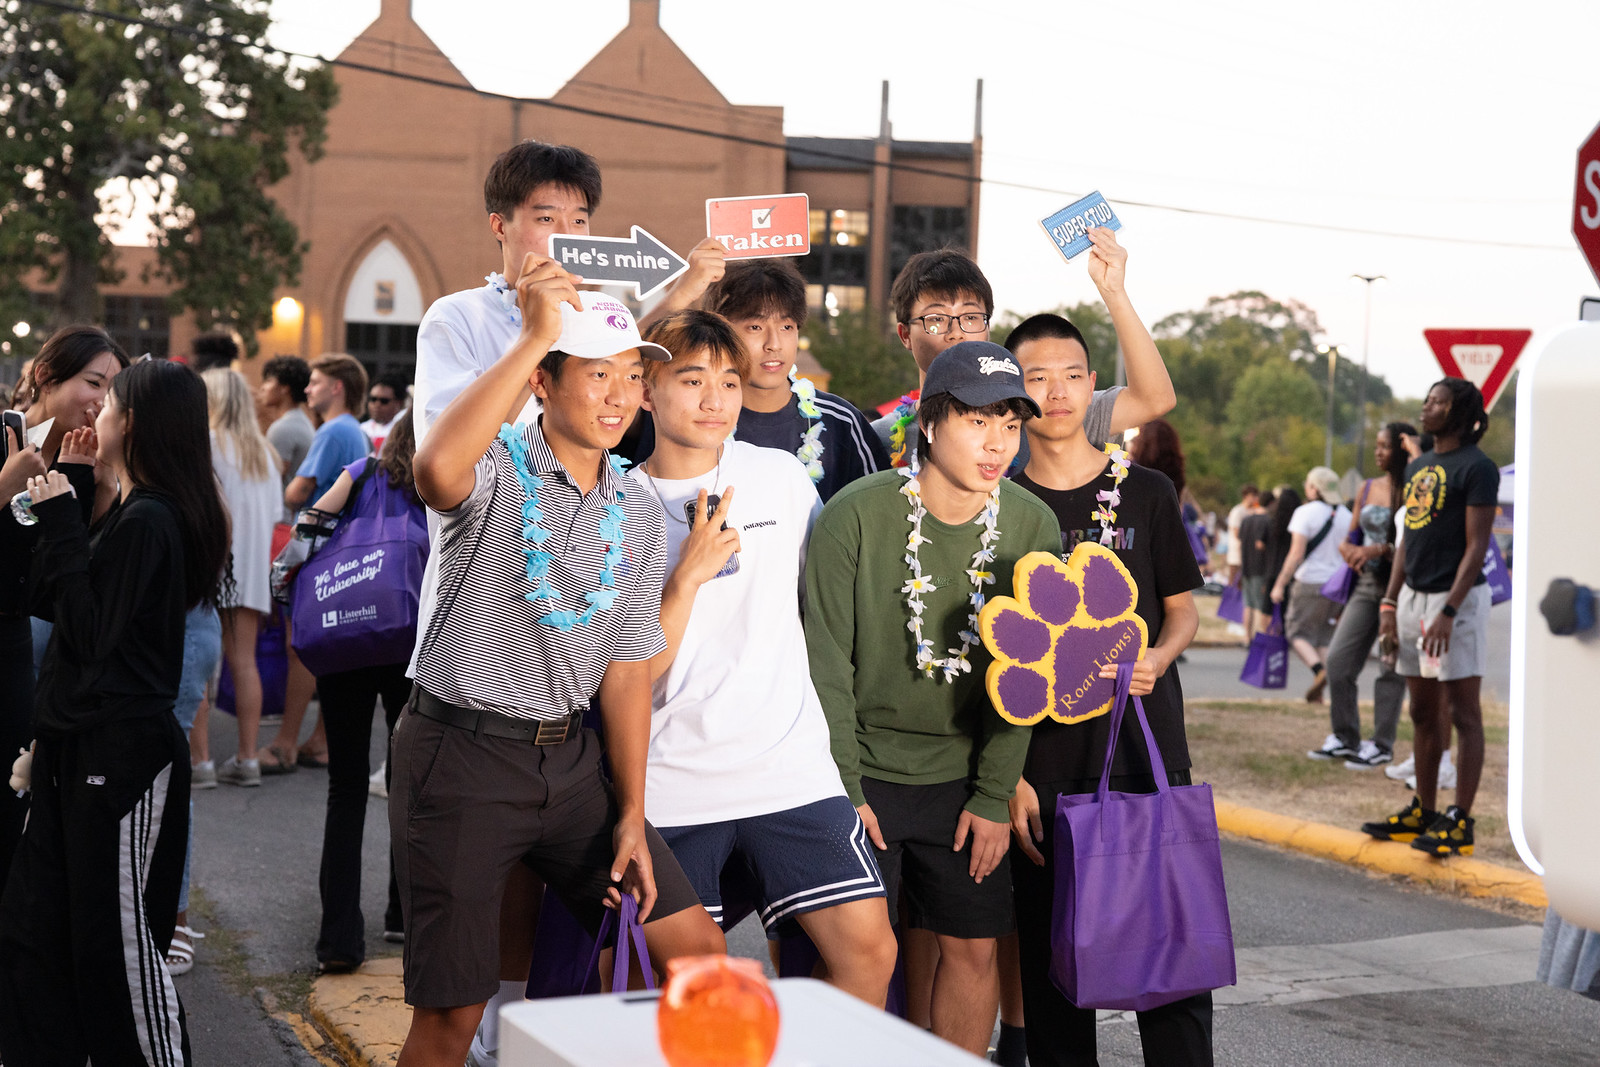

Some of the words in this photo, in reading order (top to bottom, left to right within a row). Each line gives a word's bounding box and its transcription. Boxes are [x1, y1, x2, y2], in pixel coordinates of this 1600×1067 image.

[1052, 214, 1088, 247] SUPER
[1084, 202, 1113, 229] STUD
[715, 231, 804, 252] Taken
[562, 246, 610, 267] He's
[614, 251, 670, 270] mine
[592, 305, 630, 315] ALABAMA
[596, 301, 624, 310] NORTH
[1460, 351, 1494, 366] YIELD
[743, 519, 777, 531] patagonia
[314, 569, 331, 589] We
[333, 559, 360, 577] love
[362, 549, 385, 564] our
[315, 558, 383, 601] University!
[339, 604, 377, 620] Listerhill
[1060, 671, 1096, 711] Roar
